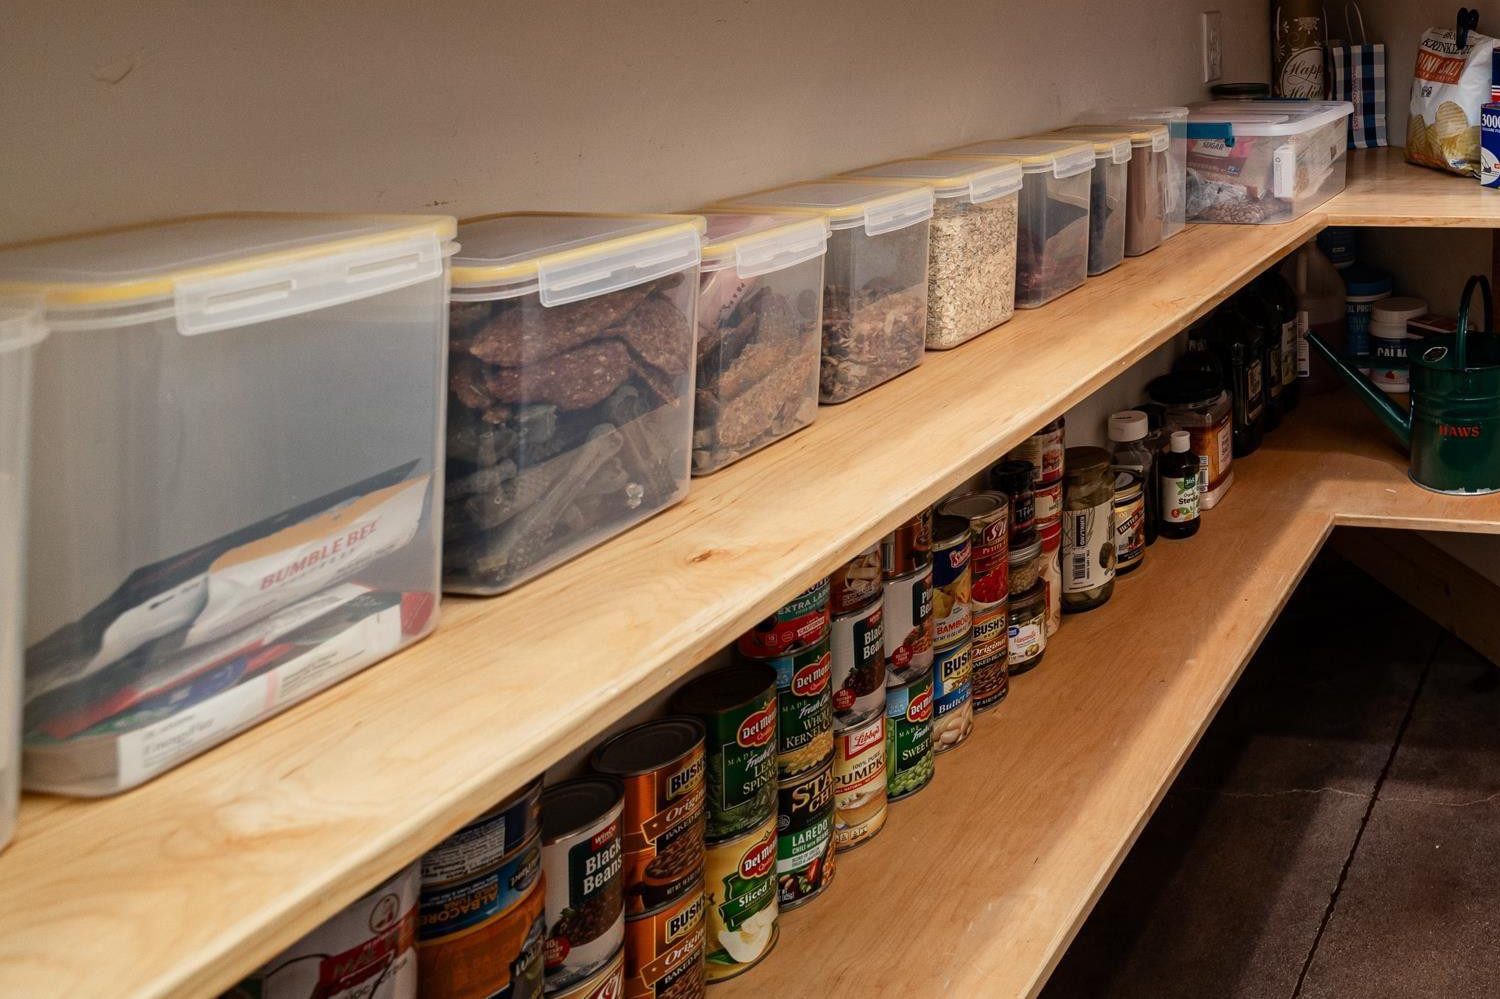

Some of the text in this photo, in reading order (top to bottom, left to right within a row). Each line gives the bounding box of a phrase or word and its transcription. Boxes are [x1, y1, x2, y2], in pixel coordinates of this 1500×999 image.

[1289, 60, 1322, 82] Happ
[1287, 84, 1322, 98] Holid
[1202, 141, 1224, 151] SUGAR
[1439, 425, 1480, 438] HAWS
[259, 519, 380, 592] BUMBLE BEE
[778, 599, 812, 615] EXTRA
[973, 615, 1005, 639] BUSH'S
[863, 640, 882, 660] Bea
[943, 647, 971, 678] BUSH
[796, 674, 813, 689] Del
[910, 702, 922, 716] Del
[938, 696, 964, 715] Butter
[743, 721, 759, 740] Del
[786, 729, 822, 749] KERNEL
[854, 726, 880, 748] Libby's
[902, 740, 929, 761] SWEET
[671, 757, 704, 791] BUSH
[835, 755, 886, 787] PUMPKI
[852, 758, 868, 772] 100%
[791, 768, 834, 814] STA
[665, 790, 704, 823] Origin
[792, 818, 829, 848] LAREDO
[585, 836, 622, 877] Black
[744, 853, 761, 872] Del
[583, 857, 622, 896] Beans
[738, 884, 768, 908] Sliced
[670, 898, 704, 937] BUSH
[664, 928, 704, 966] Origin
